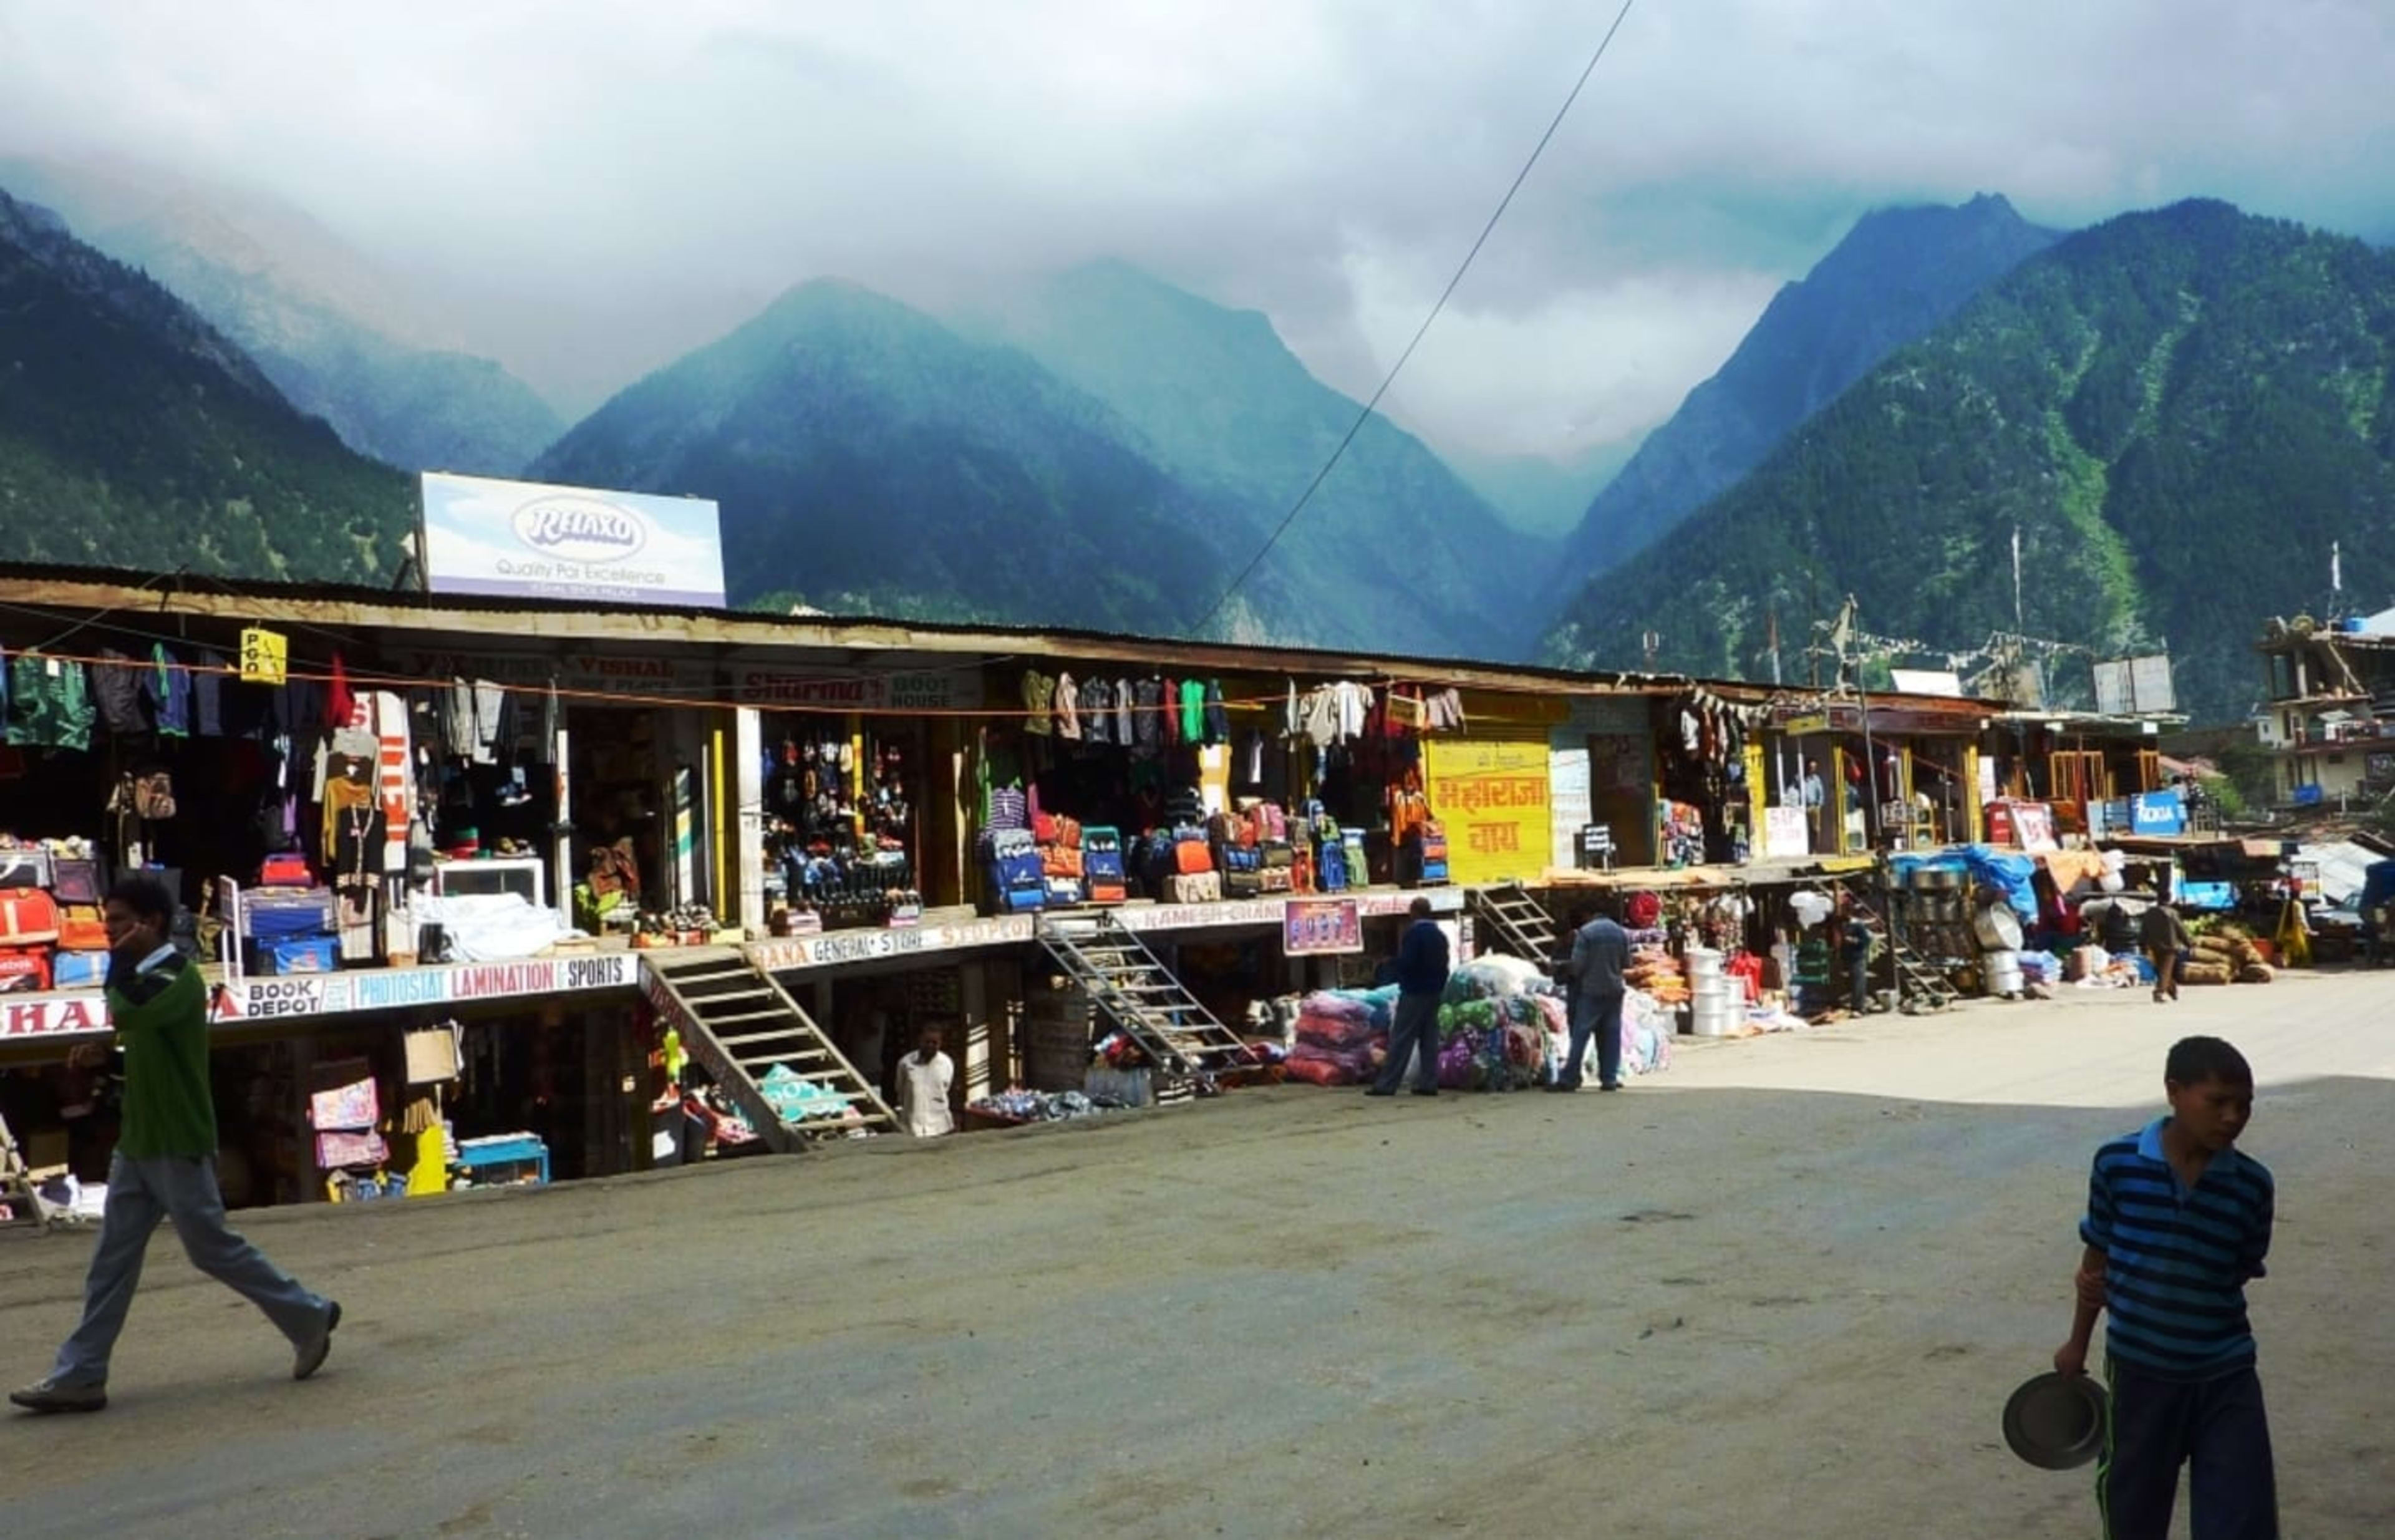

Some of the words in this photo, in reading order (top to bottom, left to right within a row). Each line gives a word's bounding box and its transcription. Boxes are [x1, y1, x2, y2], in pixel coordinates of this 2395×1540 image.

[530, 511, 633, 545] RELAXO
[496, 559, 552, 578] Quality
[585, 566, 666, 585] Excellence
[893, 694, 948, 708] HOUSE
[249, 981, 312, 1000] BOOK
[360, 971, 445, 1007] PHOTOSTAT
[452, 962, 554, 997] LAMINATION
[568, 957, 623, 987] SPORTS
[248, 998, 318, 1017] DEPOT
